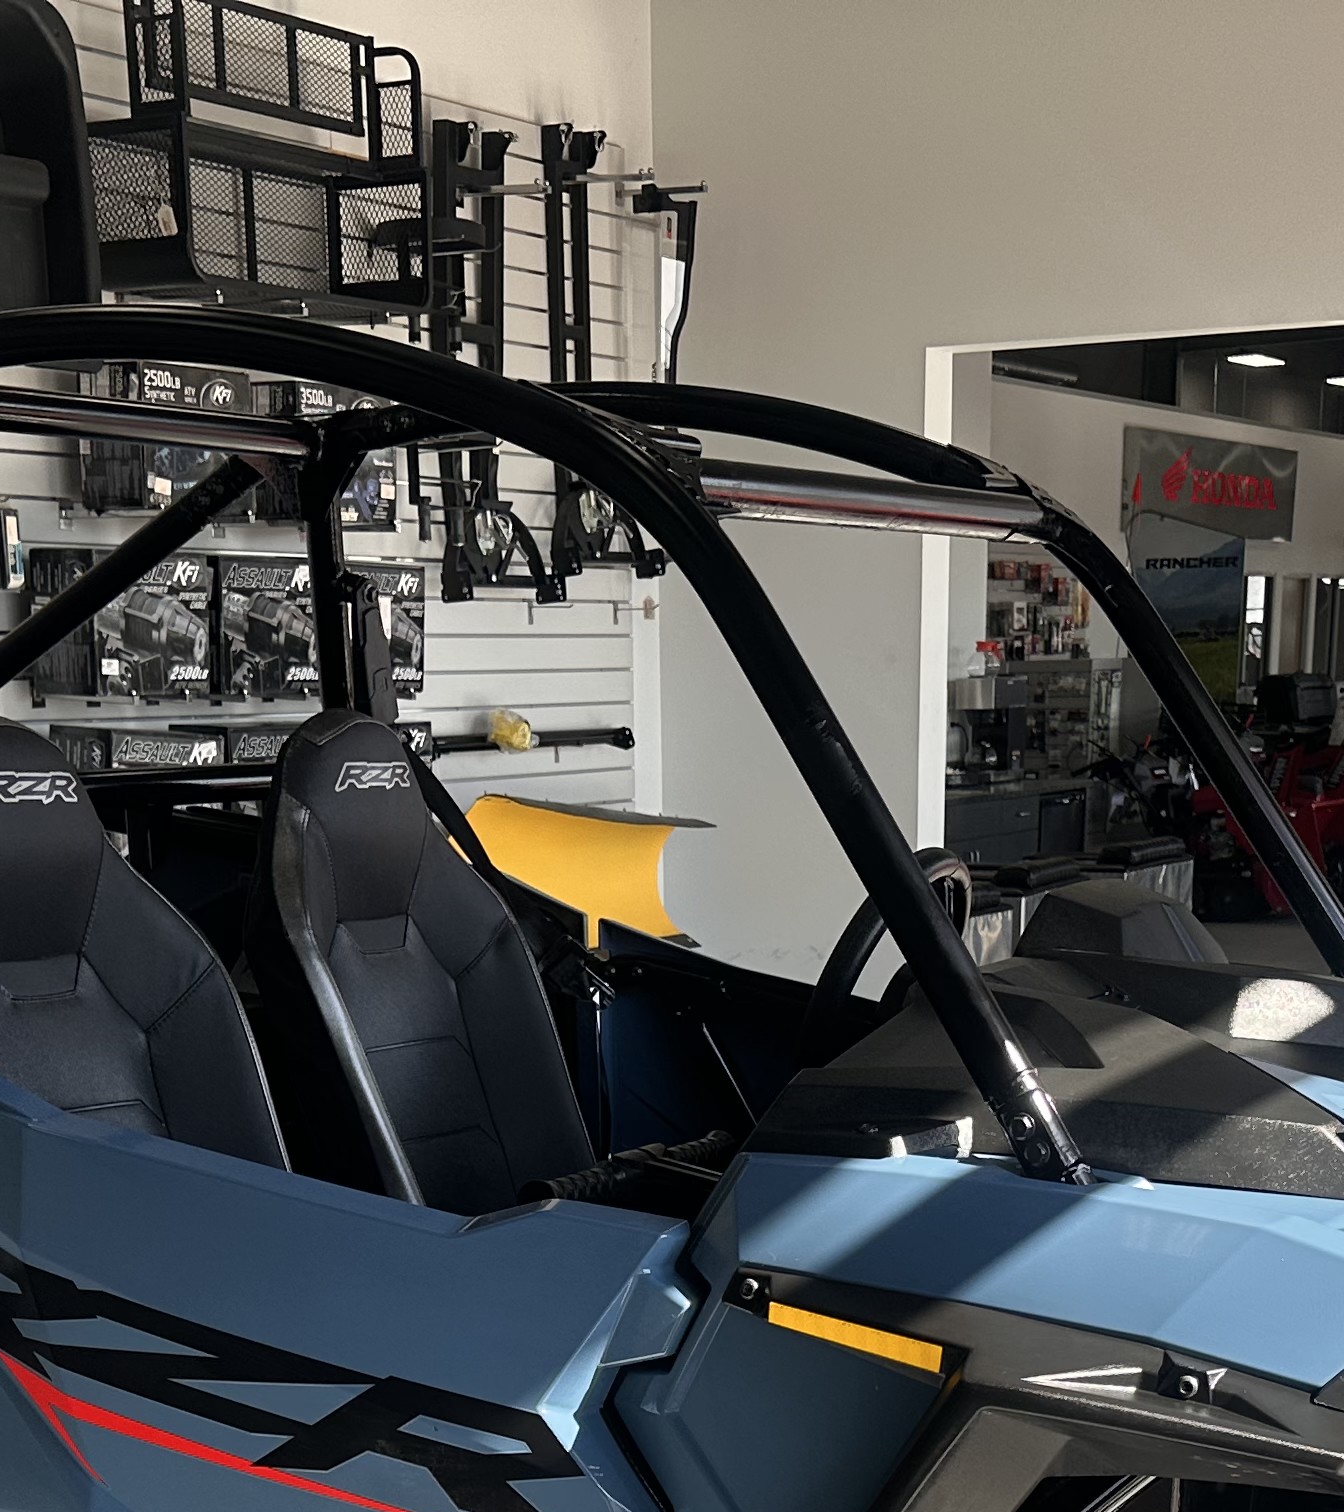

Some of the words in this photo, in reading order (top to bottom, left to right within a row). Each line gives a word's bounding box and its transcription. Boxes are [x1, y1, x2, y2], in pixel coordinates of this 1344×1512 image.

[143, 369, 181, 389] 2500LB
[300, 387, 333, 407] 3500LB
[1189, 468, 1278, 511] HONDA
[1145, 556, 1239, 570] RANCHER
[222, 563, 293, 590] ASSAULT
[169, 664, 209, 681] 2500LB
[112, 736, 191, 766] ASSAULT
[334, 761, 411, 793] RZR
